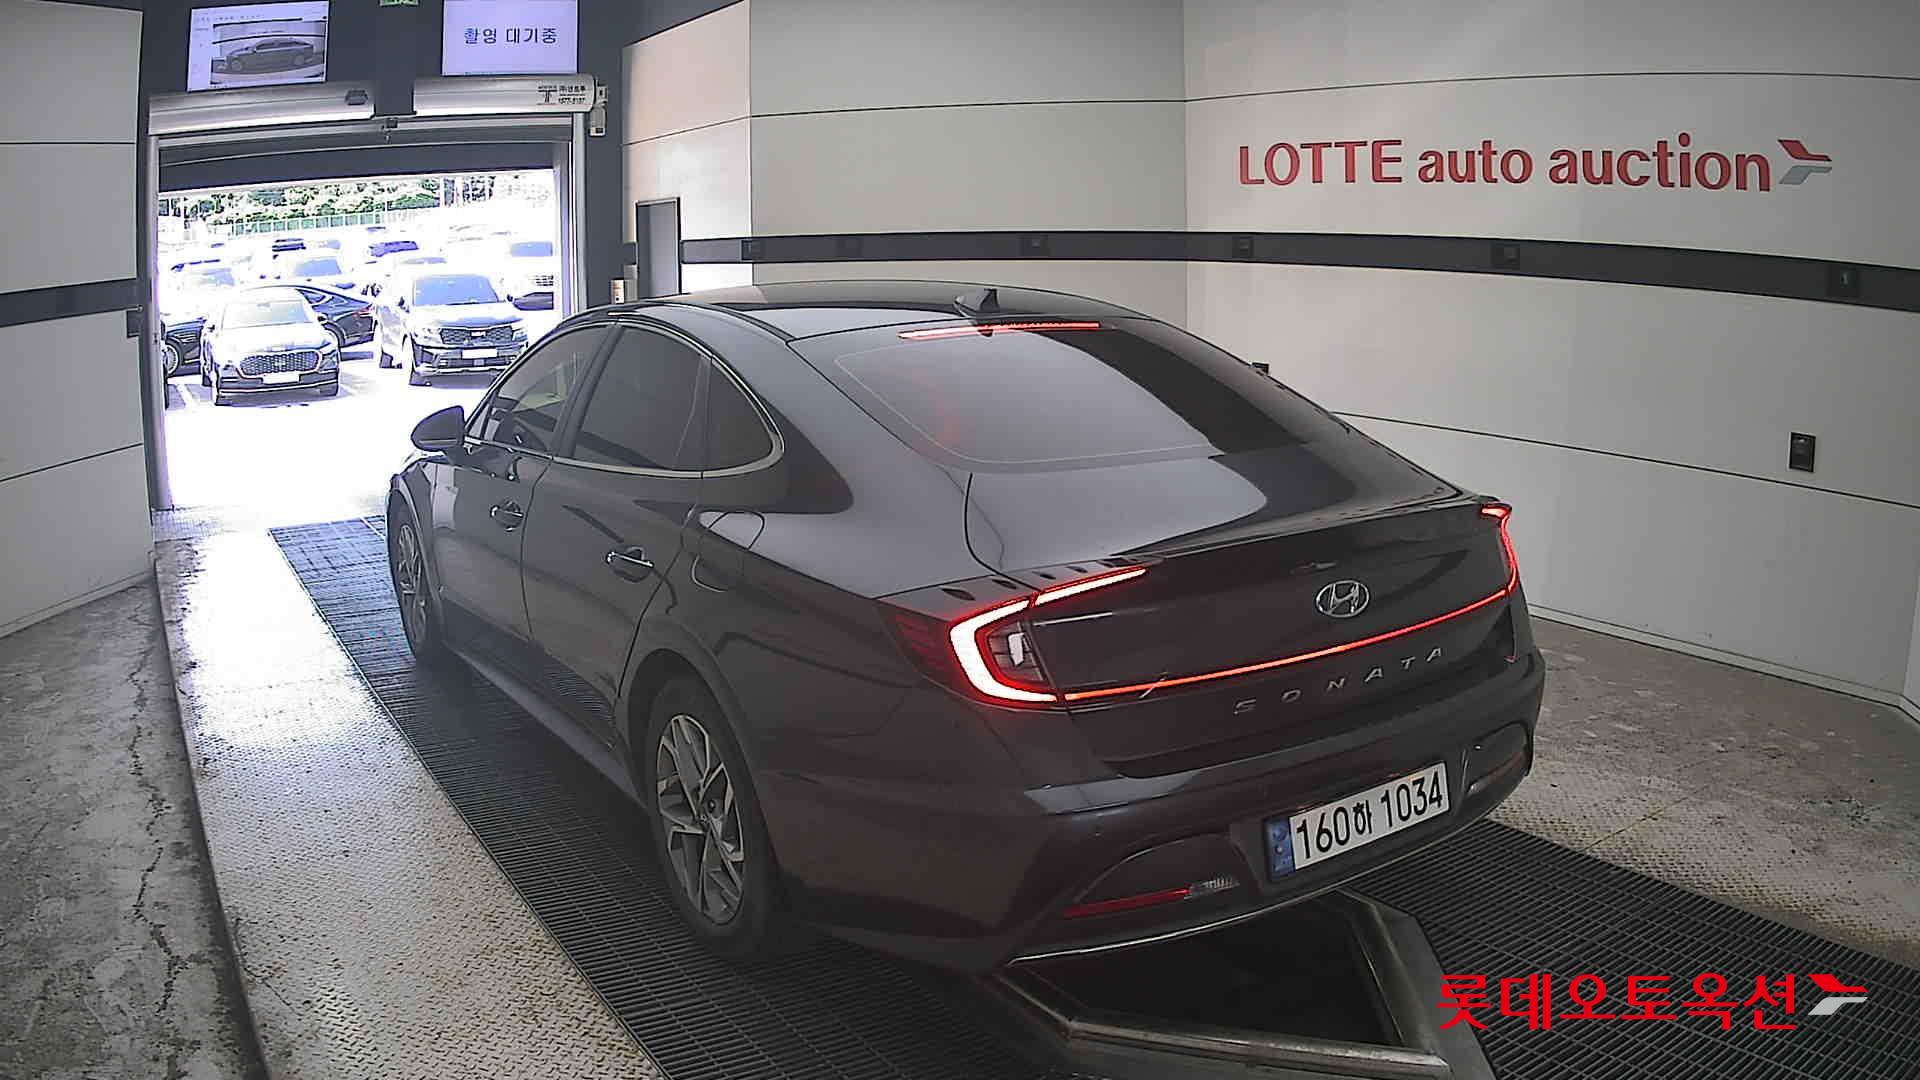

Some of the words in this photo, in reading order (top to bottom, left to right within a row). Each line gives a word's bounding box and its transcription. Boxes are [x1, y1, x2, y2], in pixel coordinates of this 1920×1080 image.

[464, 27, 497, 45] 촬영
[506, 27, 558, 45] 대기중
[1238, 139, 1402, 186] LOTTE
[1417, 140, 1534, 184] auto
[1549, 132, 1771, 192] auction
[1233, 647, 1442, 715] SONATA
[1296, 801, 1373, 860] 160하
[1381, 770, 1443, 829] 1034
